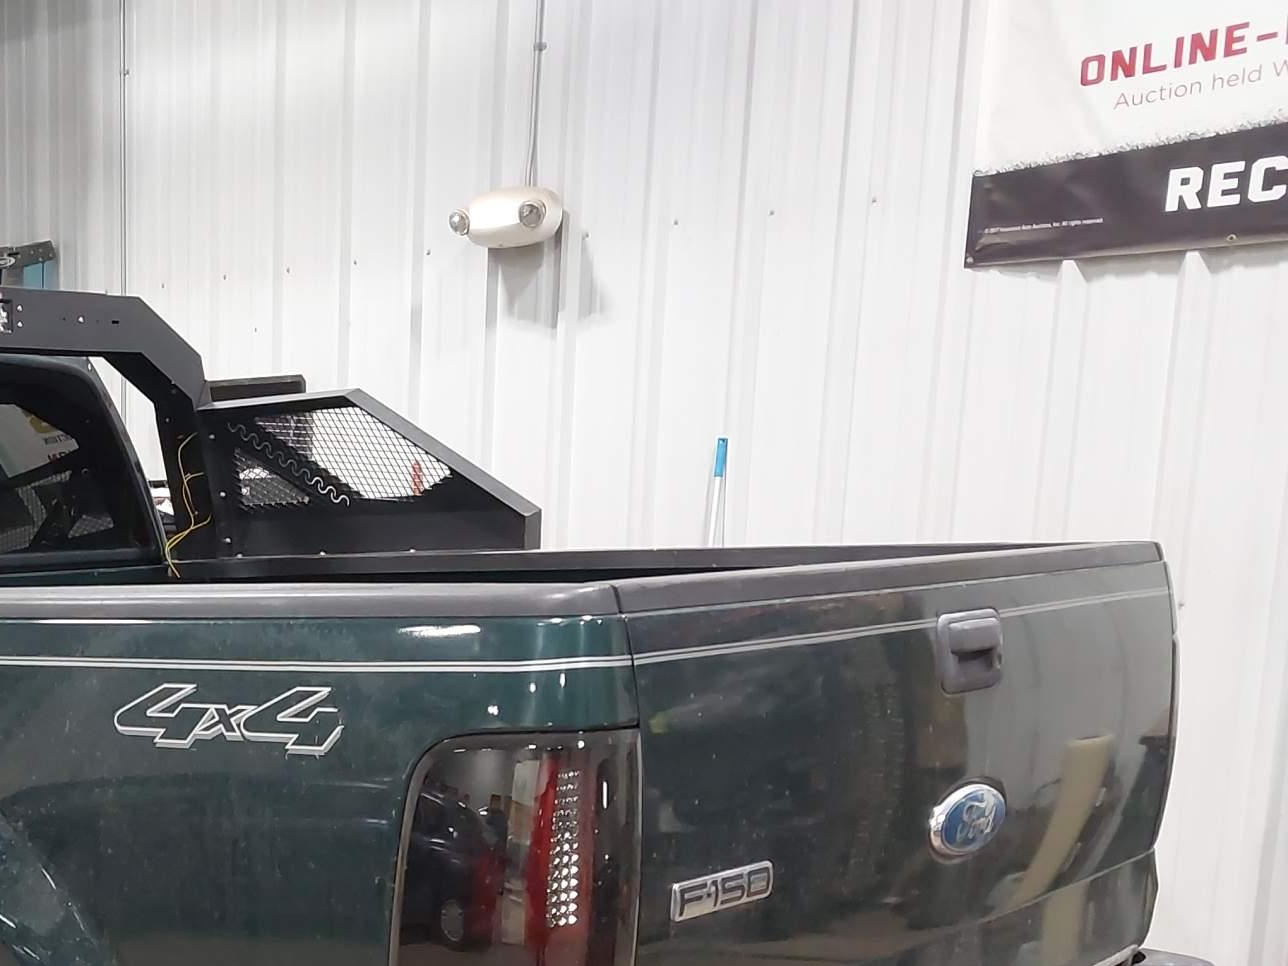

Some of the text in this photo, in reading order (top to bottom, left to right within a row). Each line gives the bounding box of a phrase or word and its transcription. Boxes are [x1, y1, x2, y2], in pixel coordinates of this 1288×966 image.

[1080, 15, 1288, 87] ONLINE-
[1113, 79, 1203, 110] Auction
[1212, 63, 1263, 90] held
[114, 683, 345, 759] 4x4
